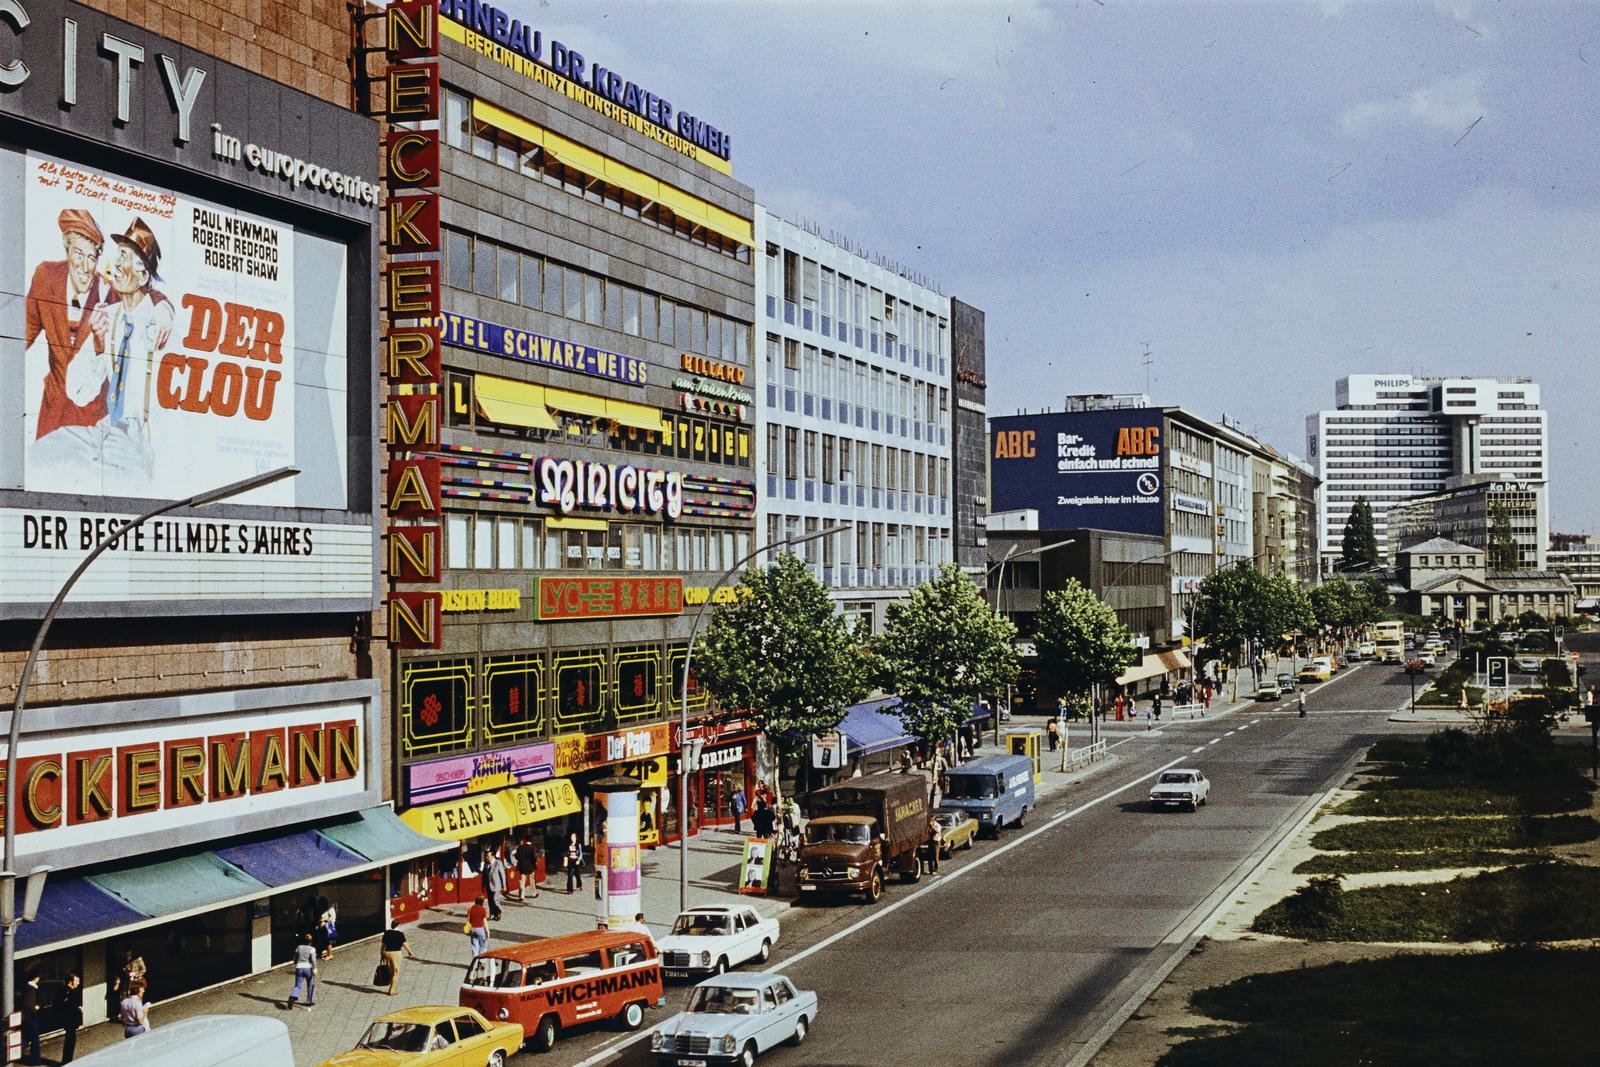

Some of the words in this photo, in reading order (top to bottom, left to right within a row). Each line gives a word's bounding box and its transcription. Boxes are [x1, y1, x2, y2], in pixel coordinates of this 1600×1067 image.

[465, 30, 515, 70] BERLIN
[521, 60, 568, 95] MAINZ
[641, 118, 698, 160] SALZBURG
[678, 111, 732, 160] GMBH
[38, 162, 58, 175] Als
[128, 185, 156, 202] Jahres
[211, 123, 241, 160] im
[245, 144, 380, 205] europacenter
[37, 175, 60, 187] mit
[75, 183, 109, 201] Oscars
[111, 195, 174, 219] ausgezeichnet
[193, 207, 222, 231] PAUL
[225, 216, 278, 246] NEWMAN
[192, 226, 230, 249] ROBERT
[234, 238, 278, 264] REDFORD
[204, 249, 243, 274] ROBERT
[247, 260, 278, 281] SHAW
[182, 293, 284, 364] DER
[387, 3, 435, 642] NECKERMANN
[503, 329, 648, 386] SCHWARZ-WEISS
[681, 354, 744, 384] BILLARD
[157, 353, 282, 421] CLOU
[1374, 379, 1410, 388] PHILIPS
[995, 430, 1036, 459] ABC
[1057, 432, 1083, 446] Bar-
[1057, 445, 1096, 458] Kredit
[1117, 427, 1159, 456] ABC
[1057, 458, 1098, 470] einfach
[1099, 457, 1120, 470] und
[1121, 455, 1159, 469] schnell
[1057, 496, 1103, 506] Zweigstelle
[1104, 495, 1120, 504] hier
[1121, 495, 1131, 504] im
[1132, 495, 1160, 504] Hause
[23, 515, 68, 550] DER
[80, 518, 145, 551] BESTE
[1491, 661, 1502, 676] P
[606, 734, 627, 762] Der
[627, 730, 651, 758] Pate
[701, 746, 743, 770] BRILLE
[0, 725, 359, 829] CKERMANN
[434, 801, 494, 834] JEANS
[520, 992, 545, 1003] RADIO
[545, 970, 658, 1008] WICHMANN
